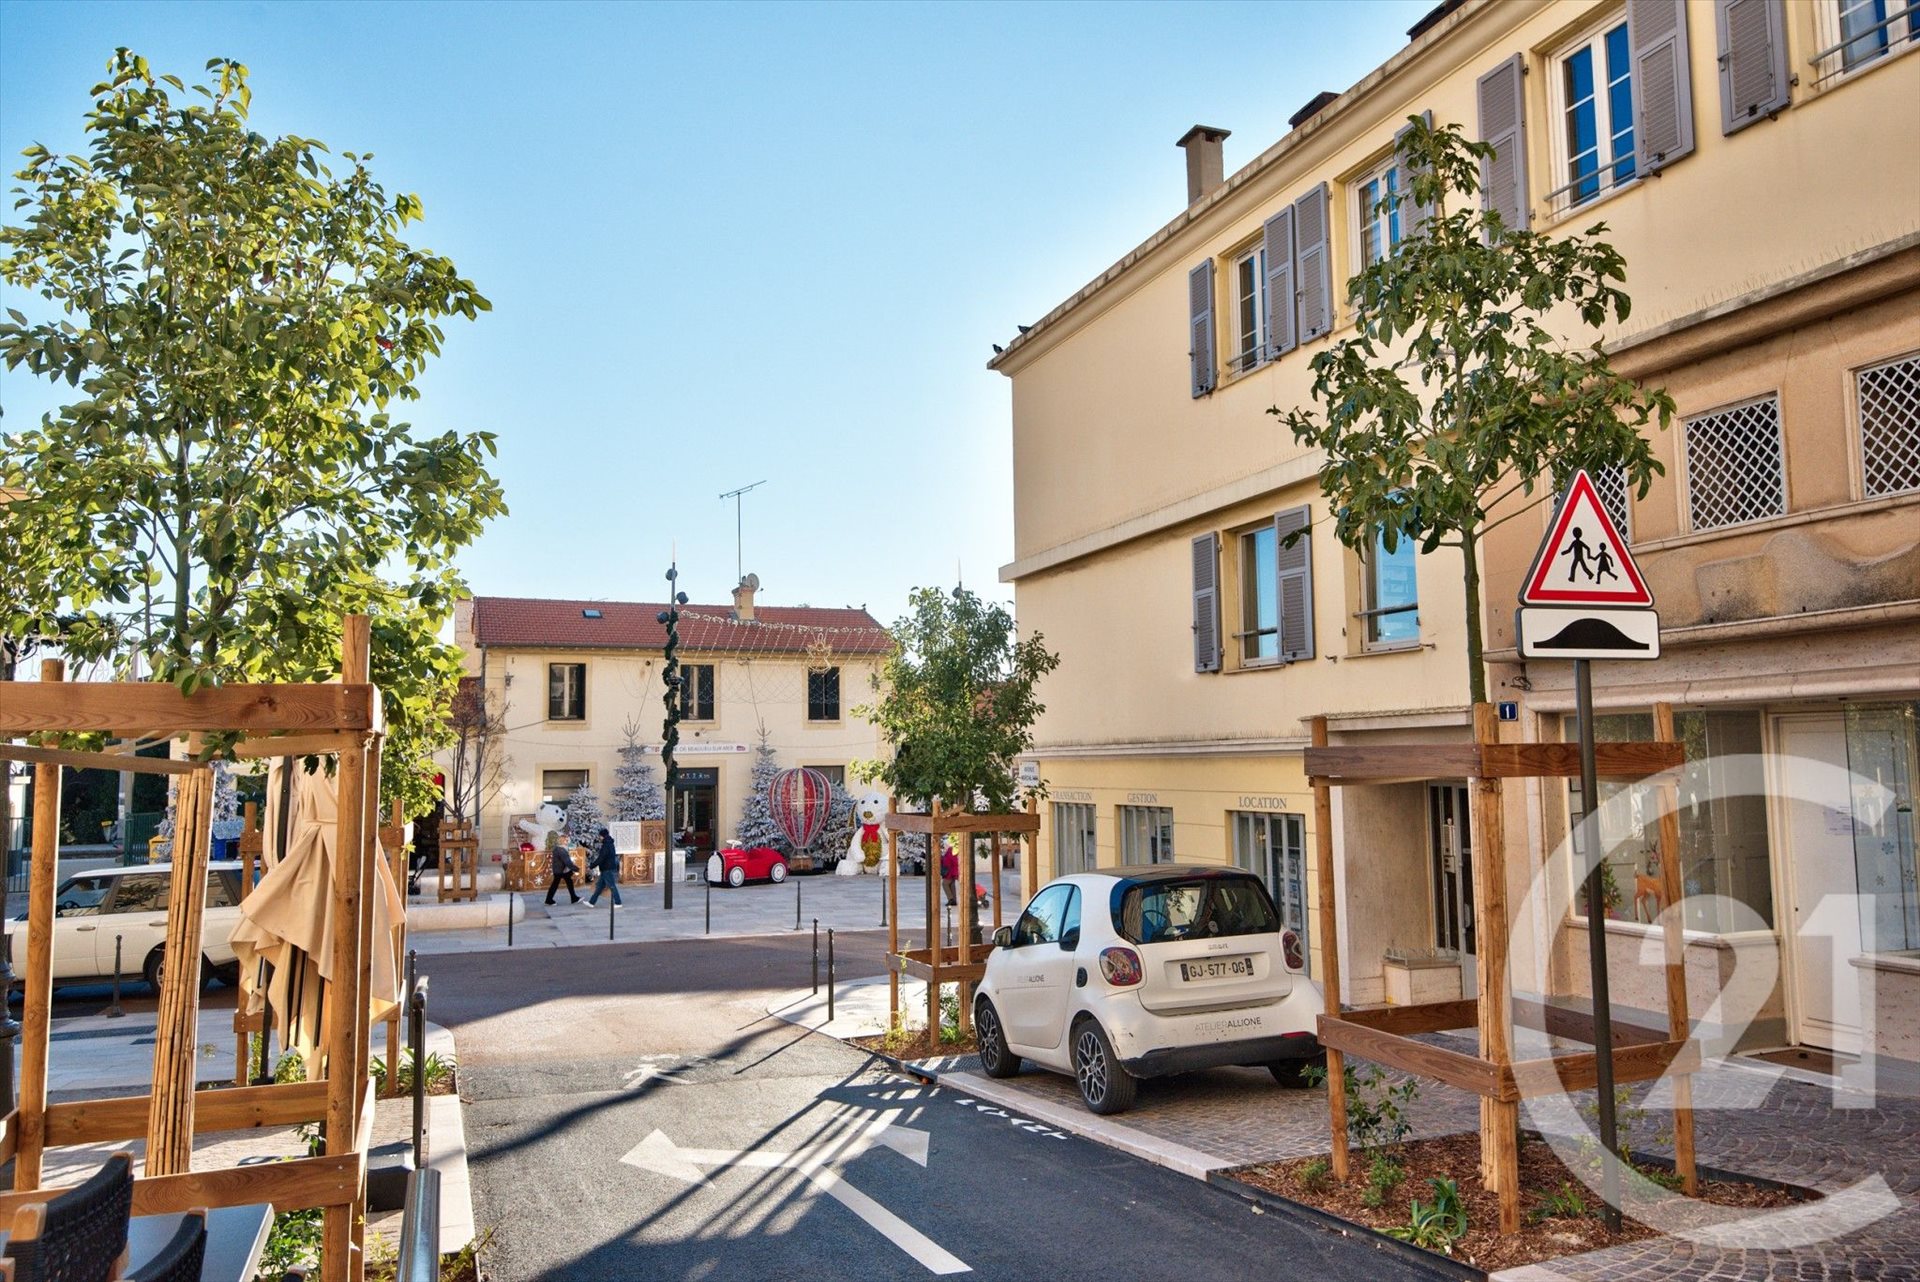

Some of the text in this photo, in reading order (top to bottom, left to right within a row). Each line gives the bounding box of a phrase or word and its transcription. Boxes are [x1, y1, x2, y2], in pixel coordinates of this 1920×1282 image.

[1505, 705, 1511, 719] 1
[1051, 790, 1093, 801] TRANSACTION
[1127, 792, 1158, 804] GESTION
[1238, 796, 1288, 809] LOCATION
